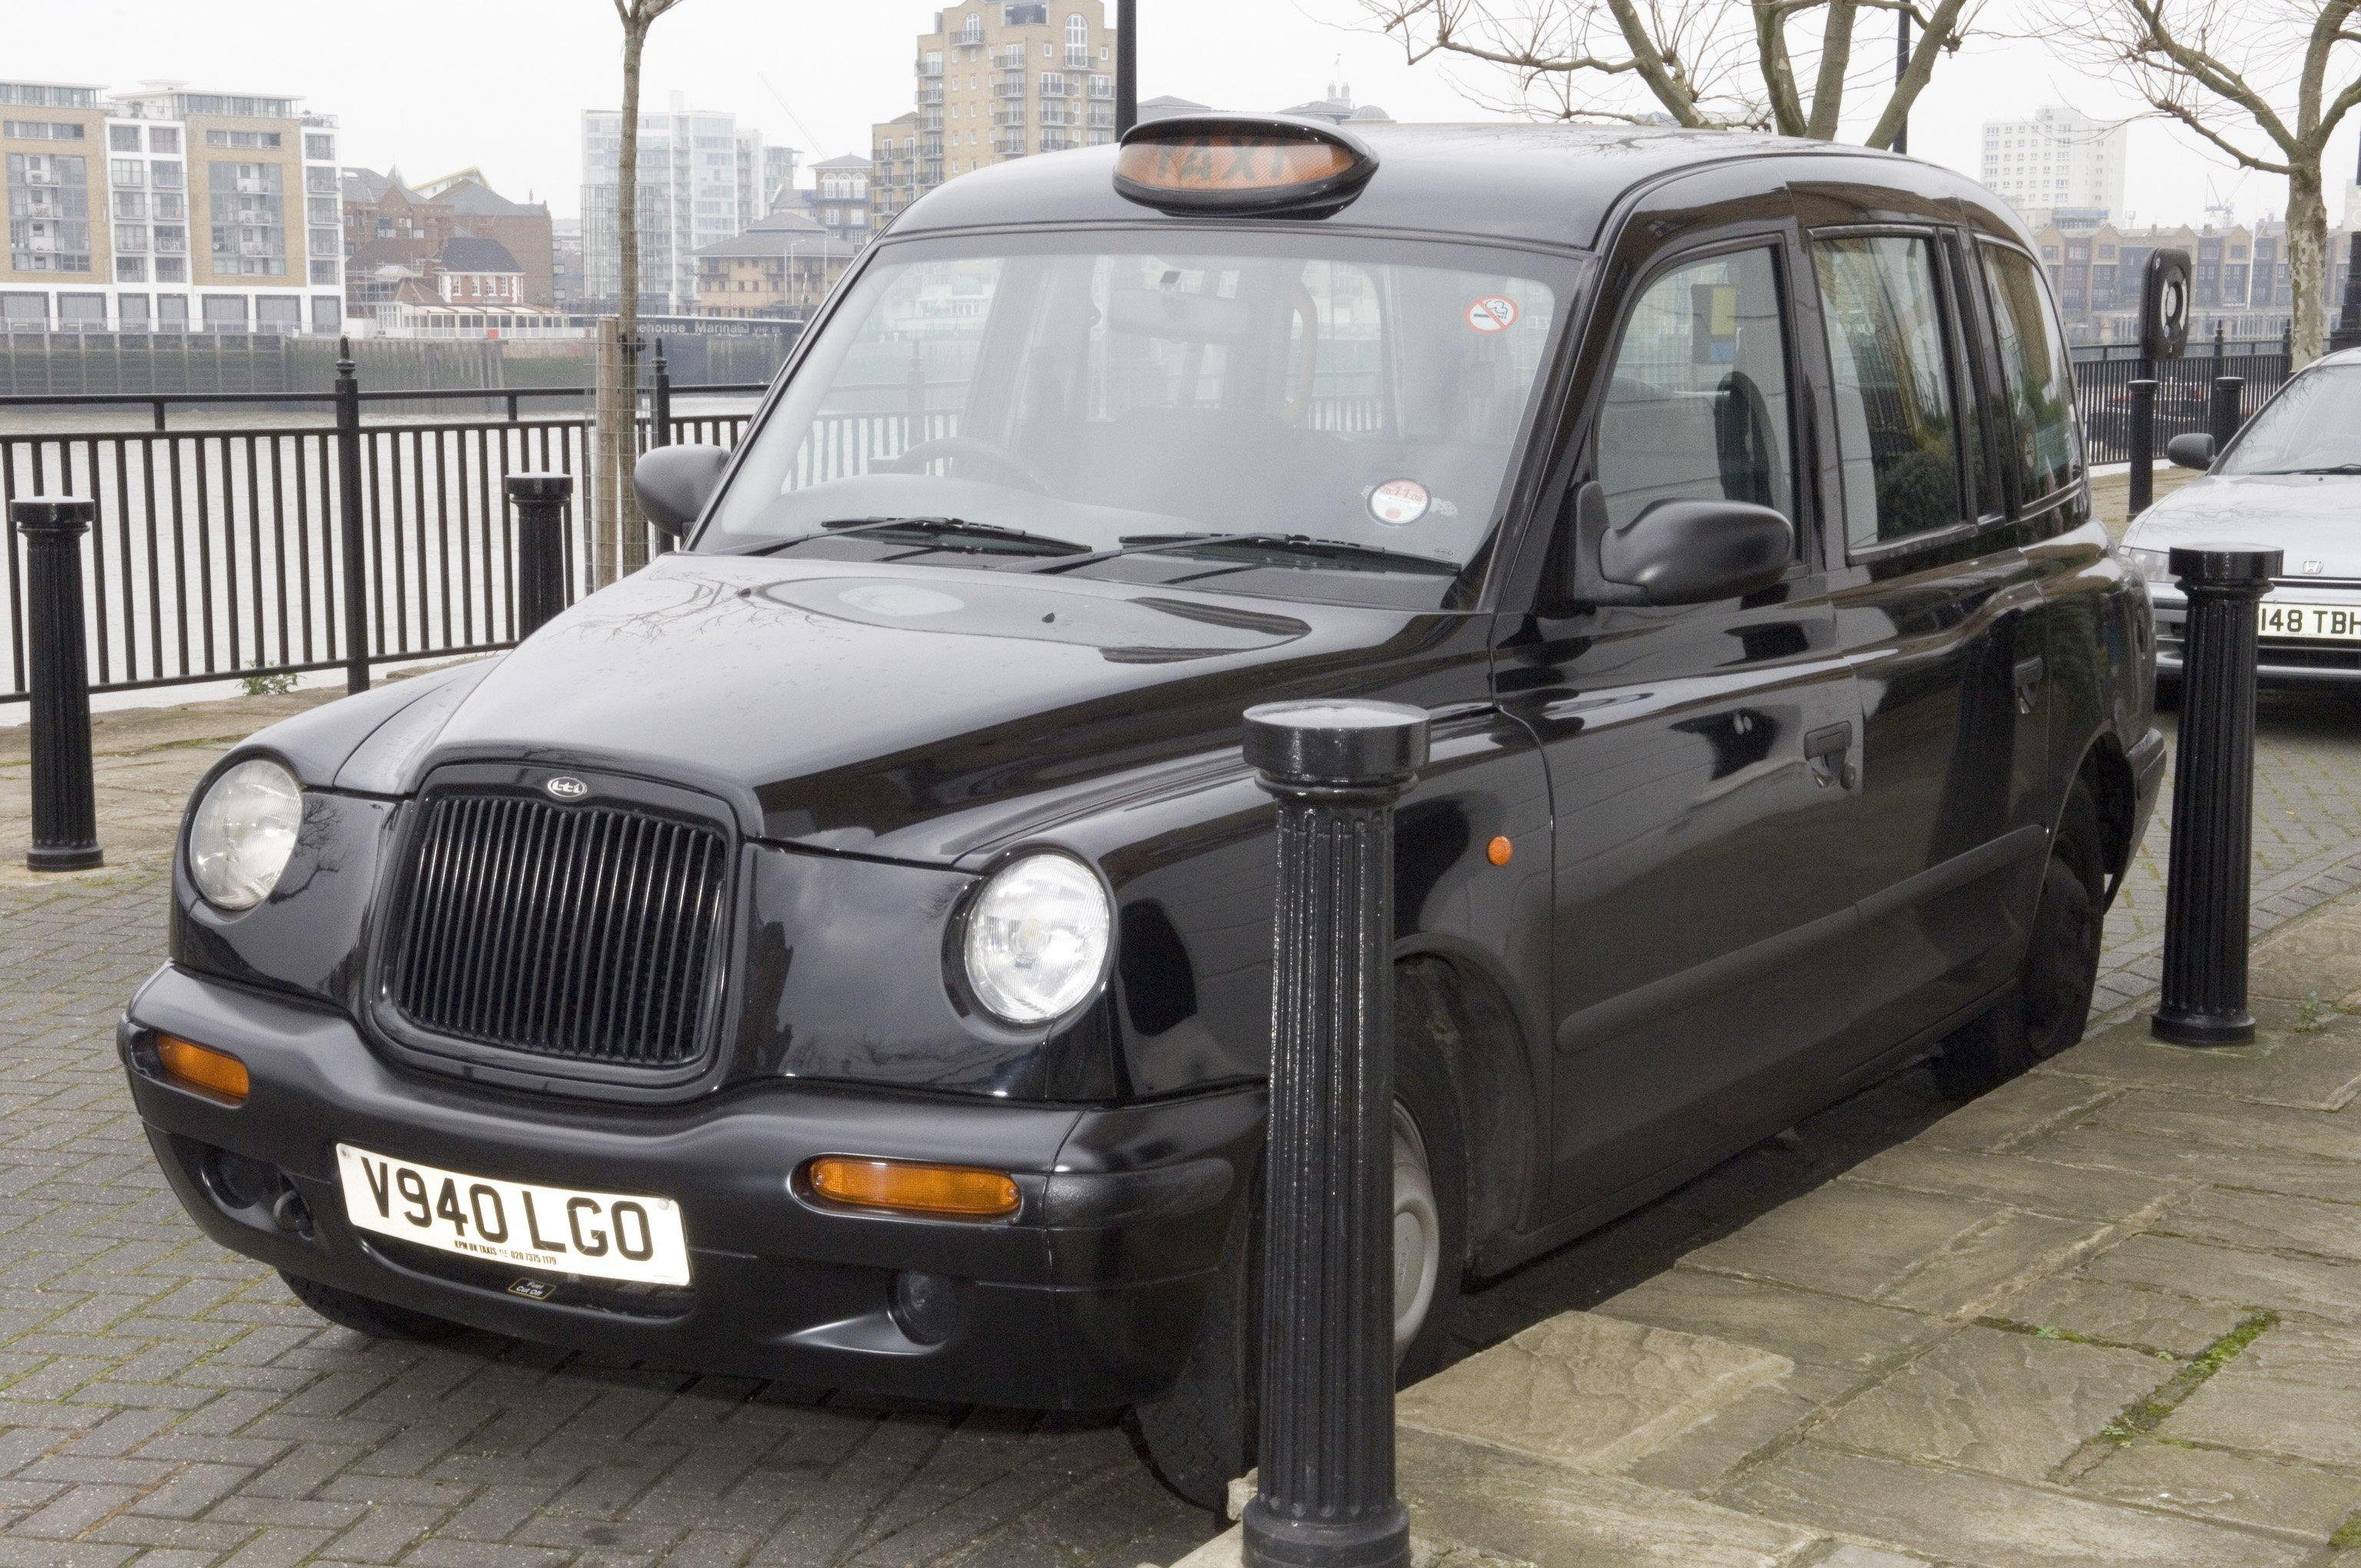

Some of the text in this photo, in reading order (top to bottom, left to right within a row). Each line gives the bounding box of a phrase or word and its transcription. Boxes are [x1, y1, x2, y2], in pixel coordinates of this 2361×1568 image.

[1154, 135, 1288, 181] TAXI
[636, 321, 686, 334] ehouse
[694, 321, 737, 334] Marina
[2313, 610, 2361, 634] TBH
[360, 1157, 653, 1261] V940 LGO
[454, 1239, 468, 1250] KPM
[469, 1243, 478, 1252] UK
[479, 1244, 497, 1256] TAXIS
[525, 1252, 540, 1263] 7375
[542, 1255, 556, 1265] 1179
